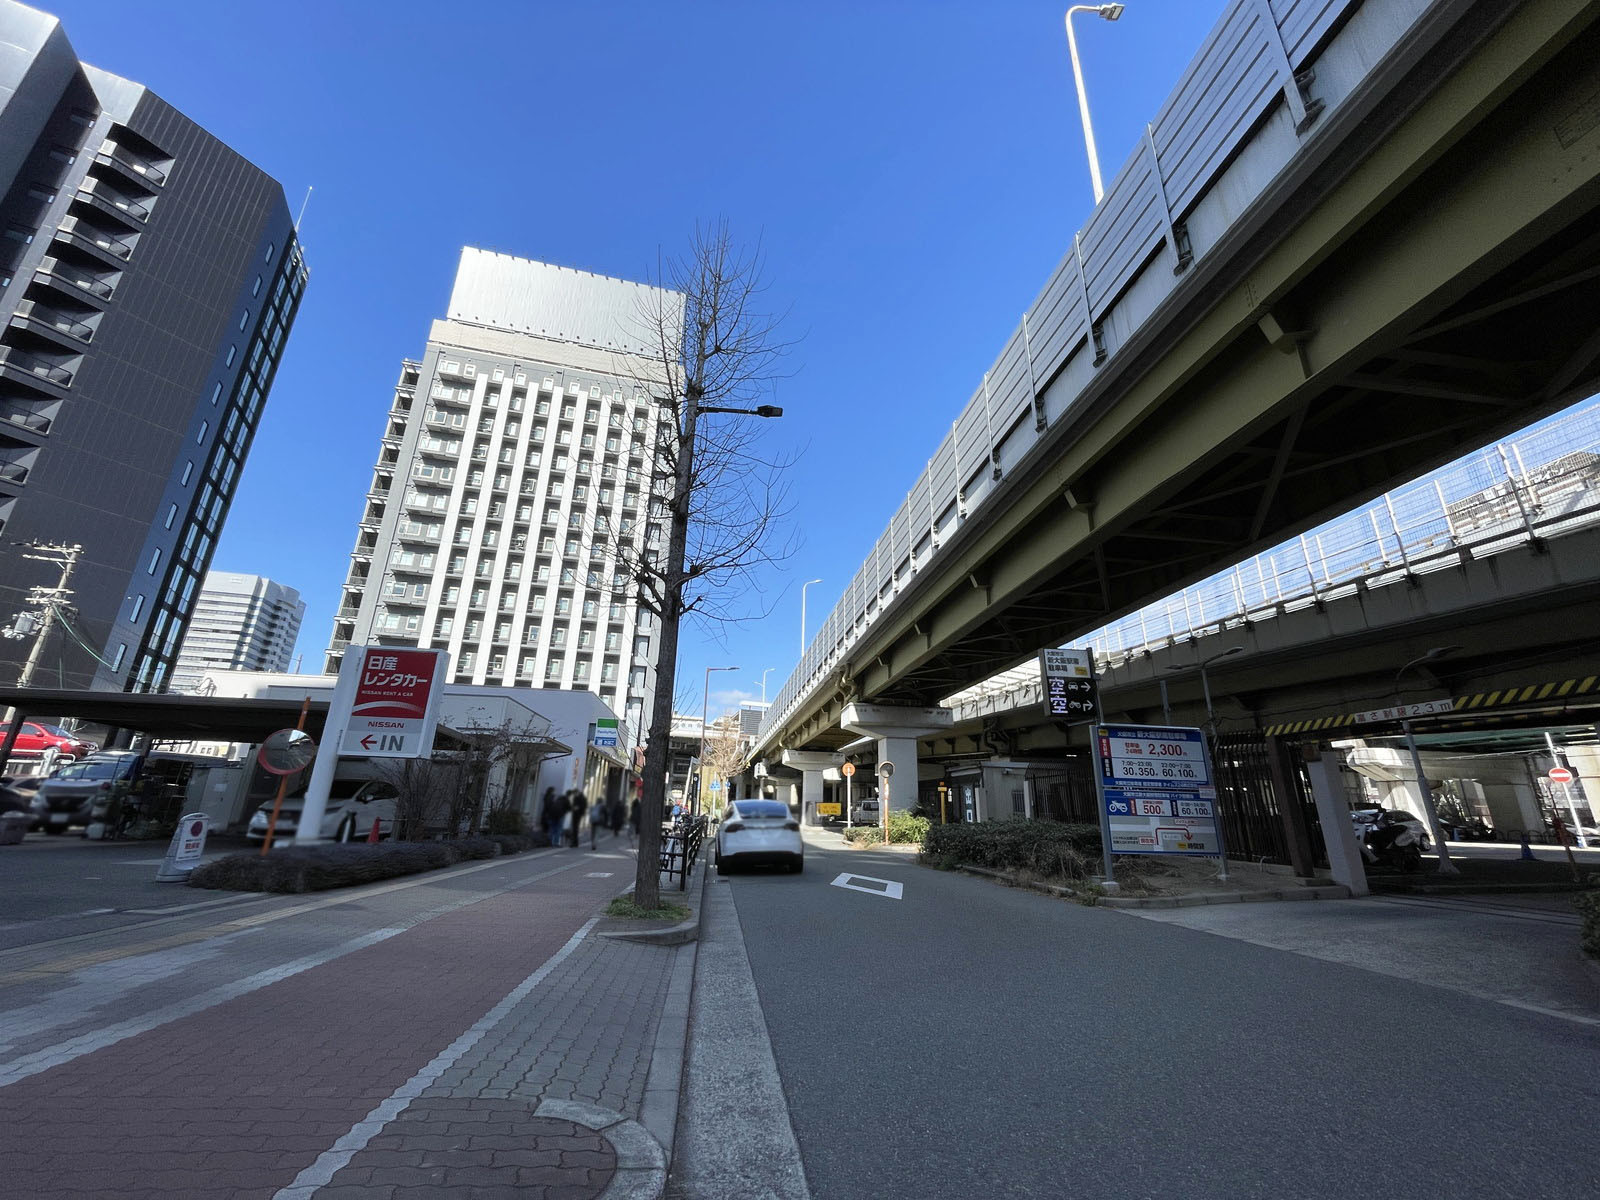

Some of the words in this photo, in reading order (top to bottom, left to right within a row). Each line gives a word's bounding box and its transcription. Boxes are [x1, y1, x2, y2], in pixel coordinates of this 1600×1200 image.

[367, 655, 398, 671] 日産
[364, 672, 428, 688] レンタカー
[1049, 677, 1066, 695] 空
[1050, 695, 1068, 714] 空
[367, 721, 405, 729] NISSAN
[379, 734, 405, 751] IN
